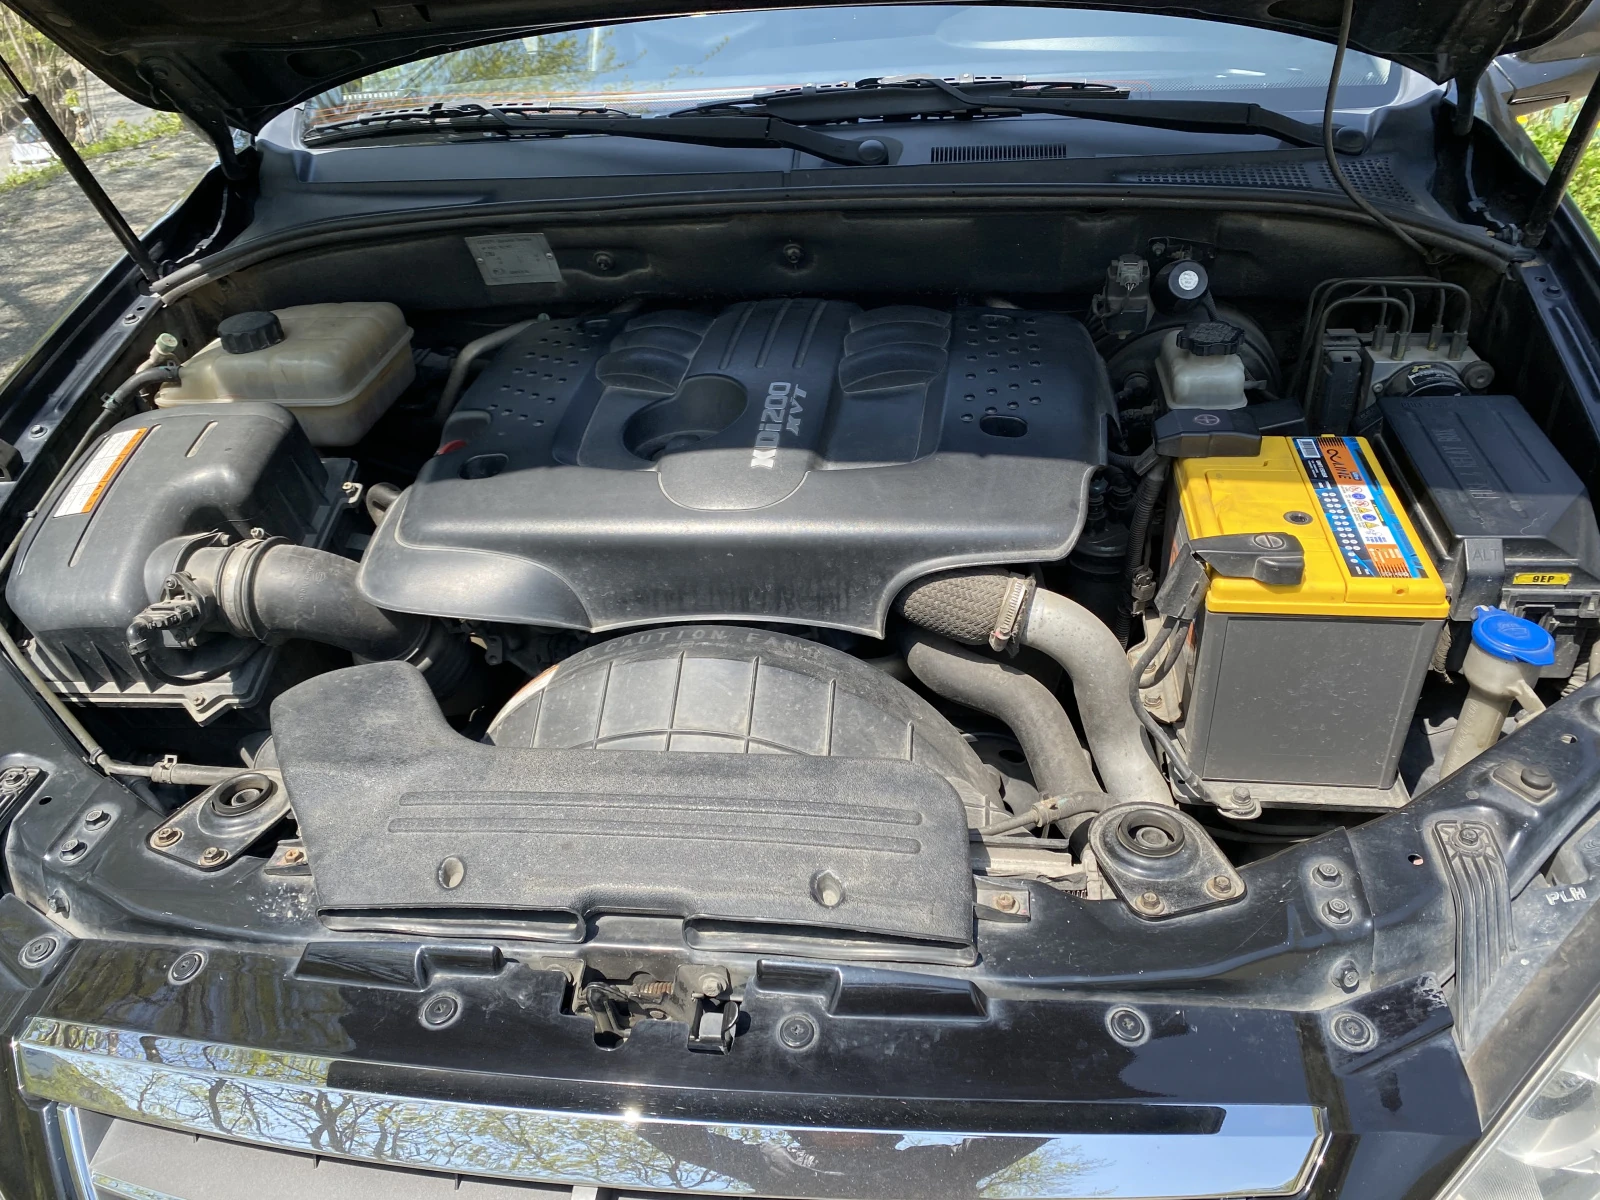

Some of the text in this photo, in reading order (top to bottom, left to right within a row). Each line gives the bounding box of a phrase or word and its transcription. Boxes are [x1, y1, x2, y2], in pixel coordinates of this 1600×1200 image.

[786, 384, 807, 436] XVT
[1472, 547, 1500, 562] ALT
[1532, 575, 1555, 583] 9EP
[604, 629, 727, 652] CAUTION
[1546, 887, 1586, 905] PLH
